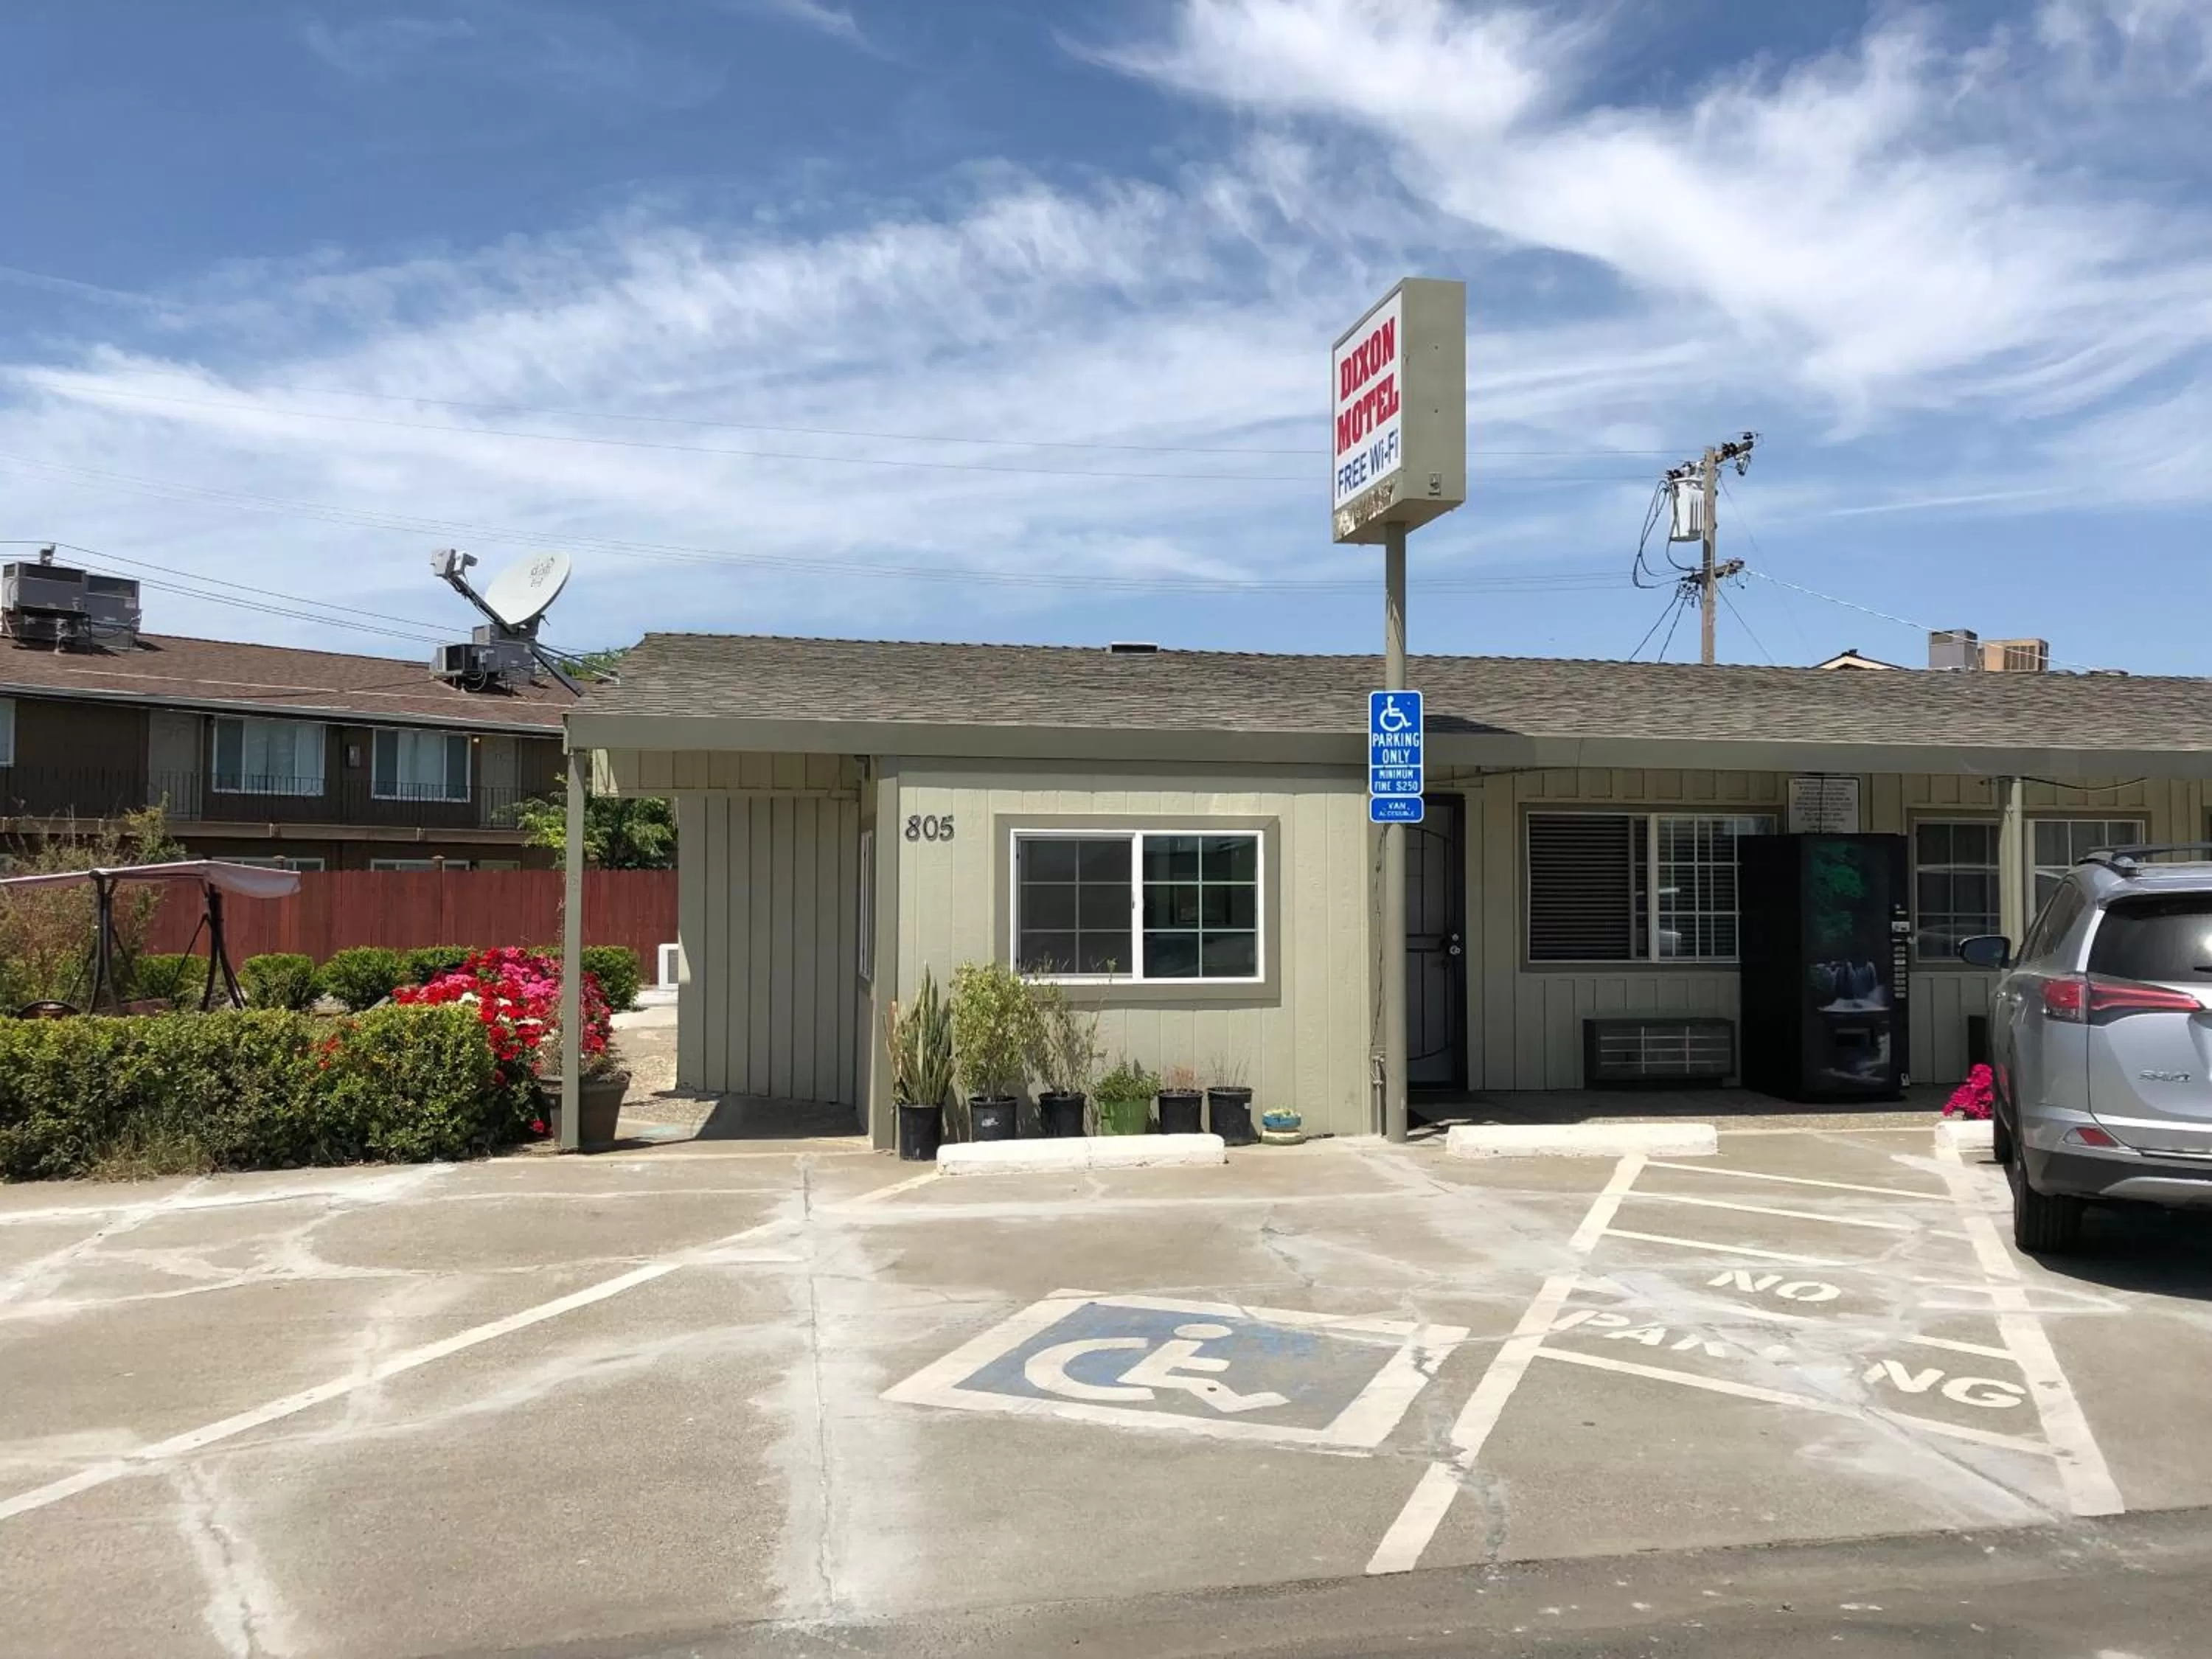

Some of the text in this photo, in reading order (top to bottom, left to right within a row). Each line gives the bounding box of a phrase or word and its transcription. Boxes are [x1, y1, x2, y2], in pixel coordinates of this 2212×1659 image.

[1340, 316, 1396, 402] DIXON
[1337, 373, 1399, 456] MOTEL
[1338, 428, 1399, 499] FREE Wi-Fi
[1372, 732, 1419, 747] PARKING
[1382, 748, 1411, 764] ONLY
[1379, 769, 1413, 779] MINIMUM
[1388, 801, 1406, 810] VAN
[905, 815, 955, 842] 805
[1707, 1270, 1841, 1301] NO
[1550, 1310, 2026, 1408] PANG
